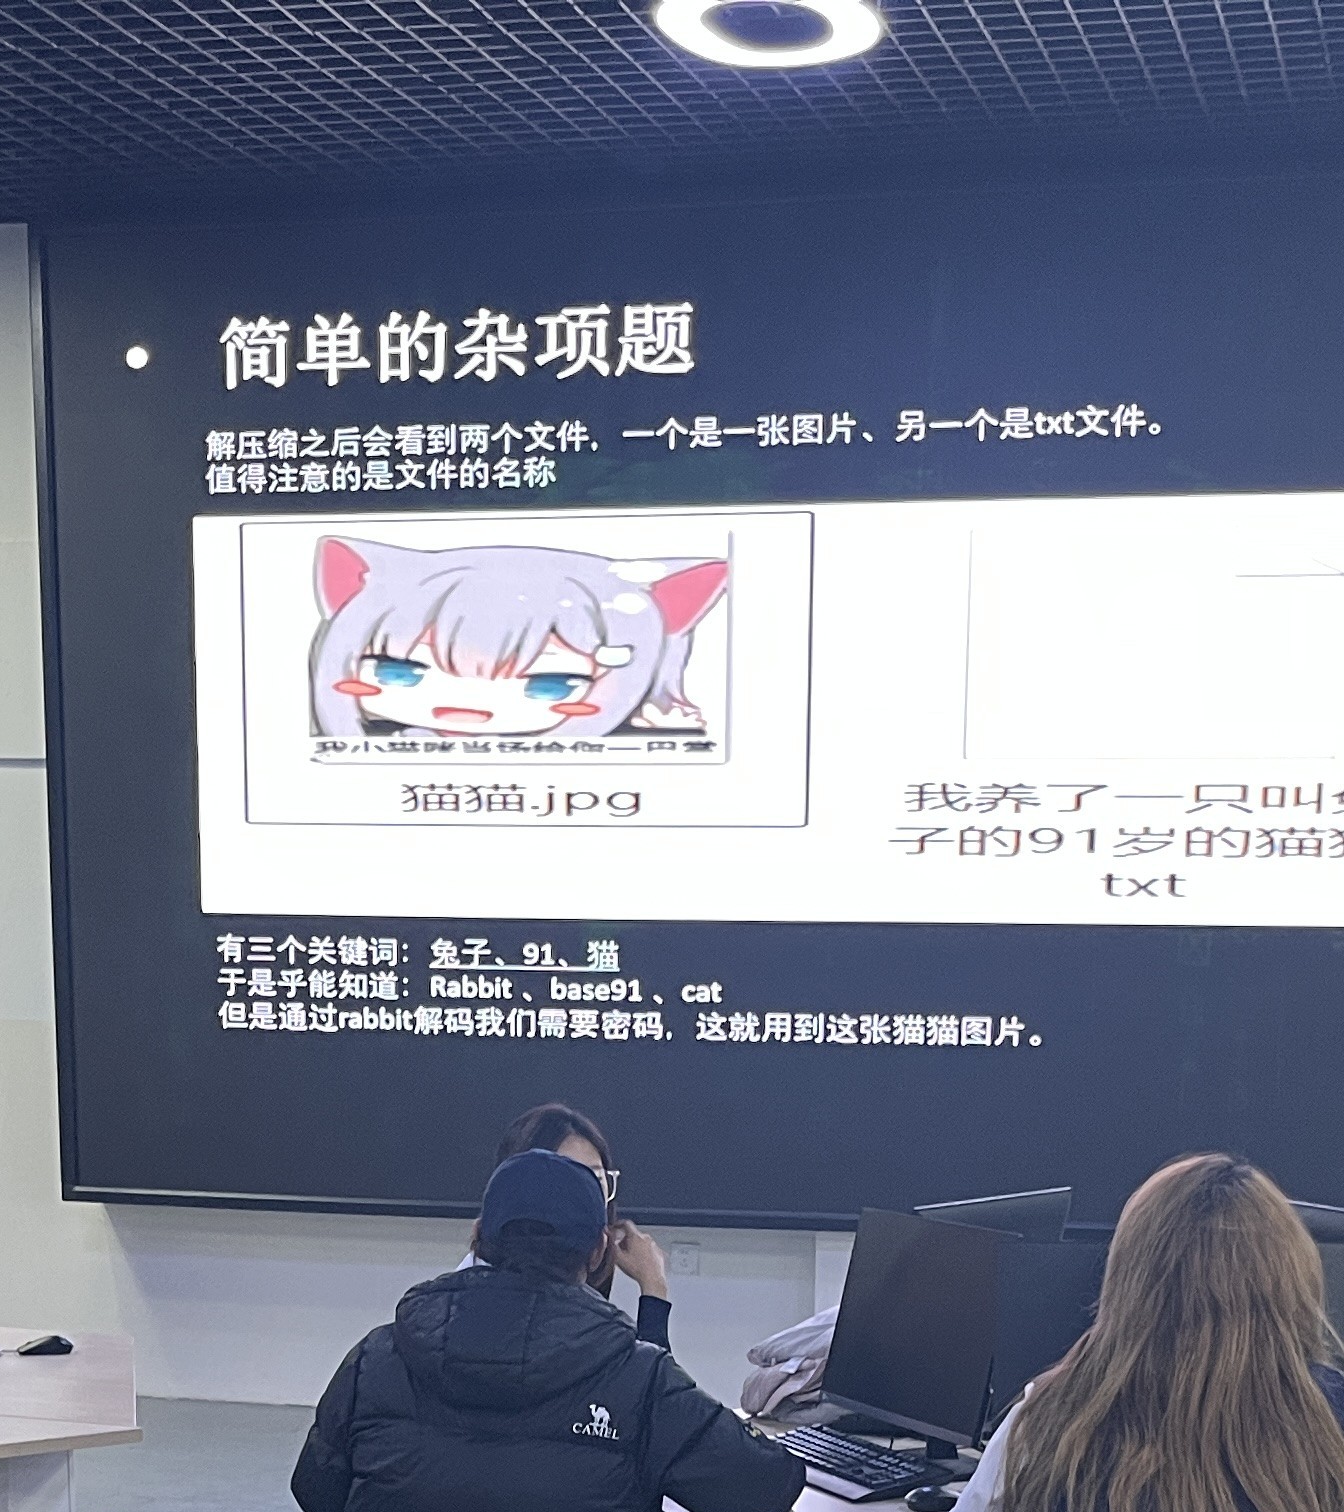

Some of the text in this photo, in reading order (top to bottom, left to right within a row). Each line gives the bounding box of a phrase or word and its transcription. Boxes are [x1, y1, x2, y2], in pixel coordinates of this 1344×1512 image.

[219, 302, 695, 390] 简单的杂项题
[205, 456, 557, 495] 值得注意的是文件的名称
[400, 783, 642, 818] 猫猫.jpg
[1100, 872, 1187, 898] txt
[572, 1422, 620, 1441] CAMEL
